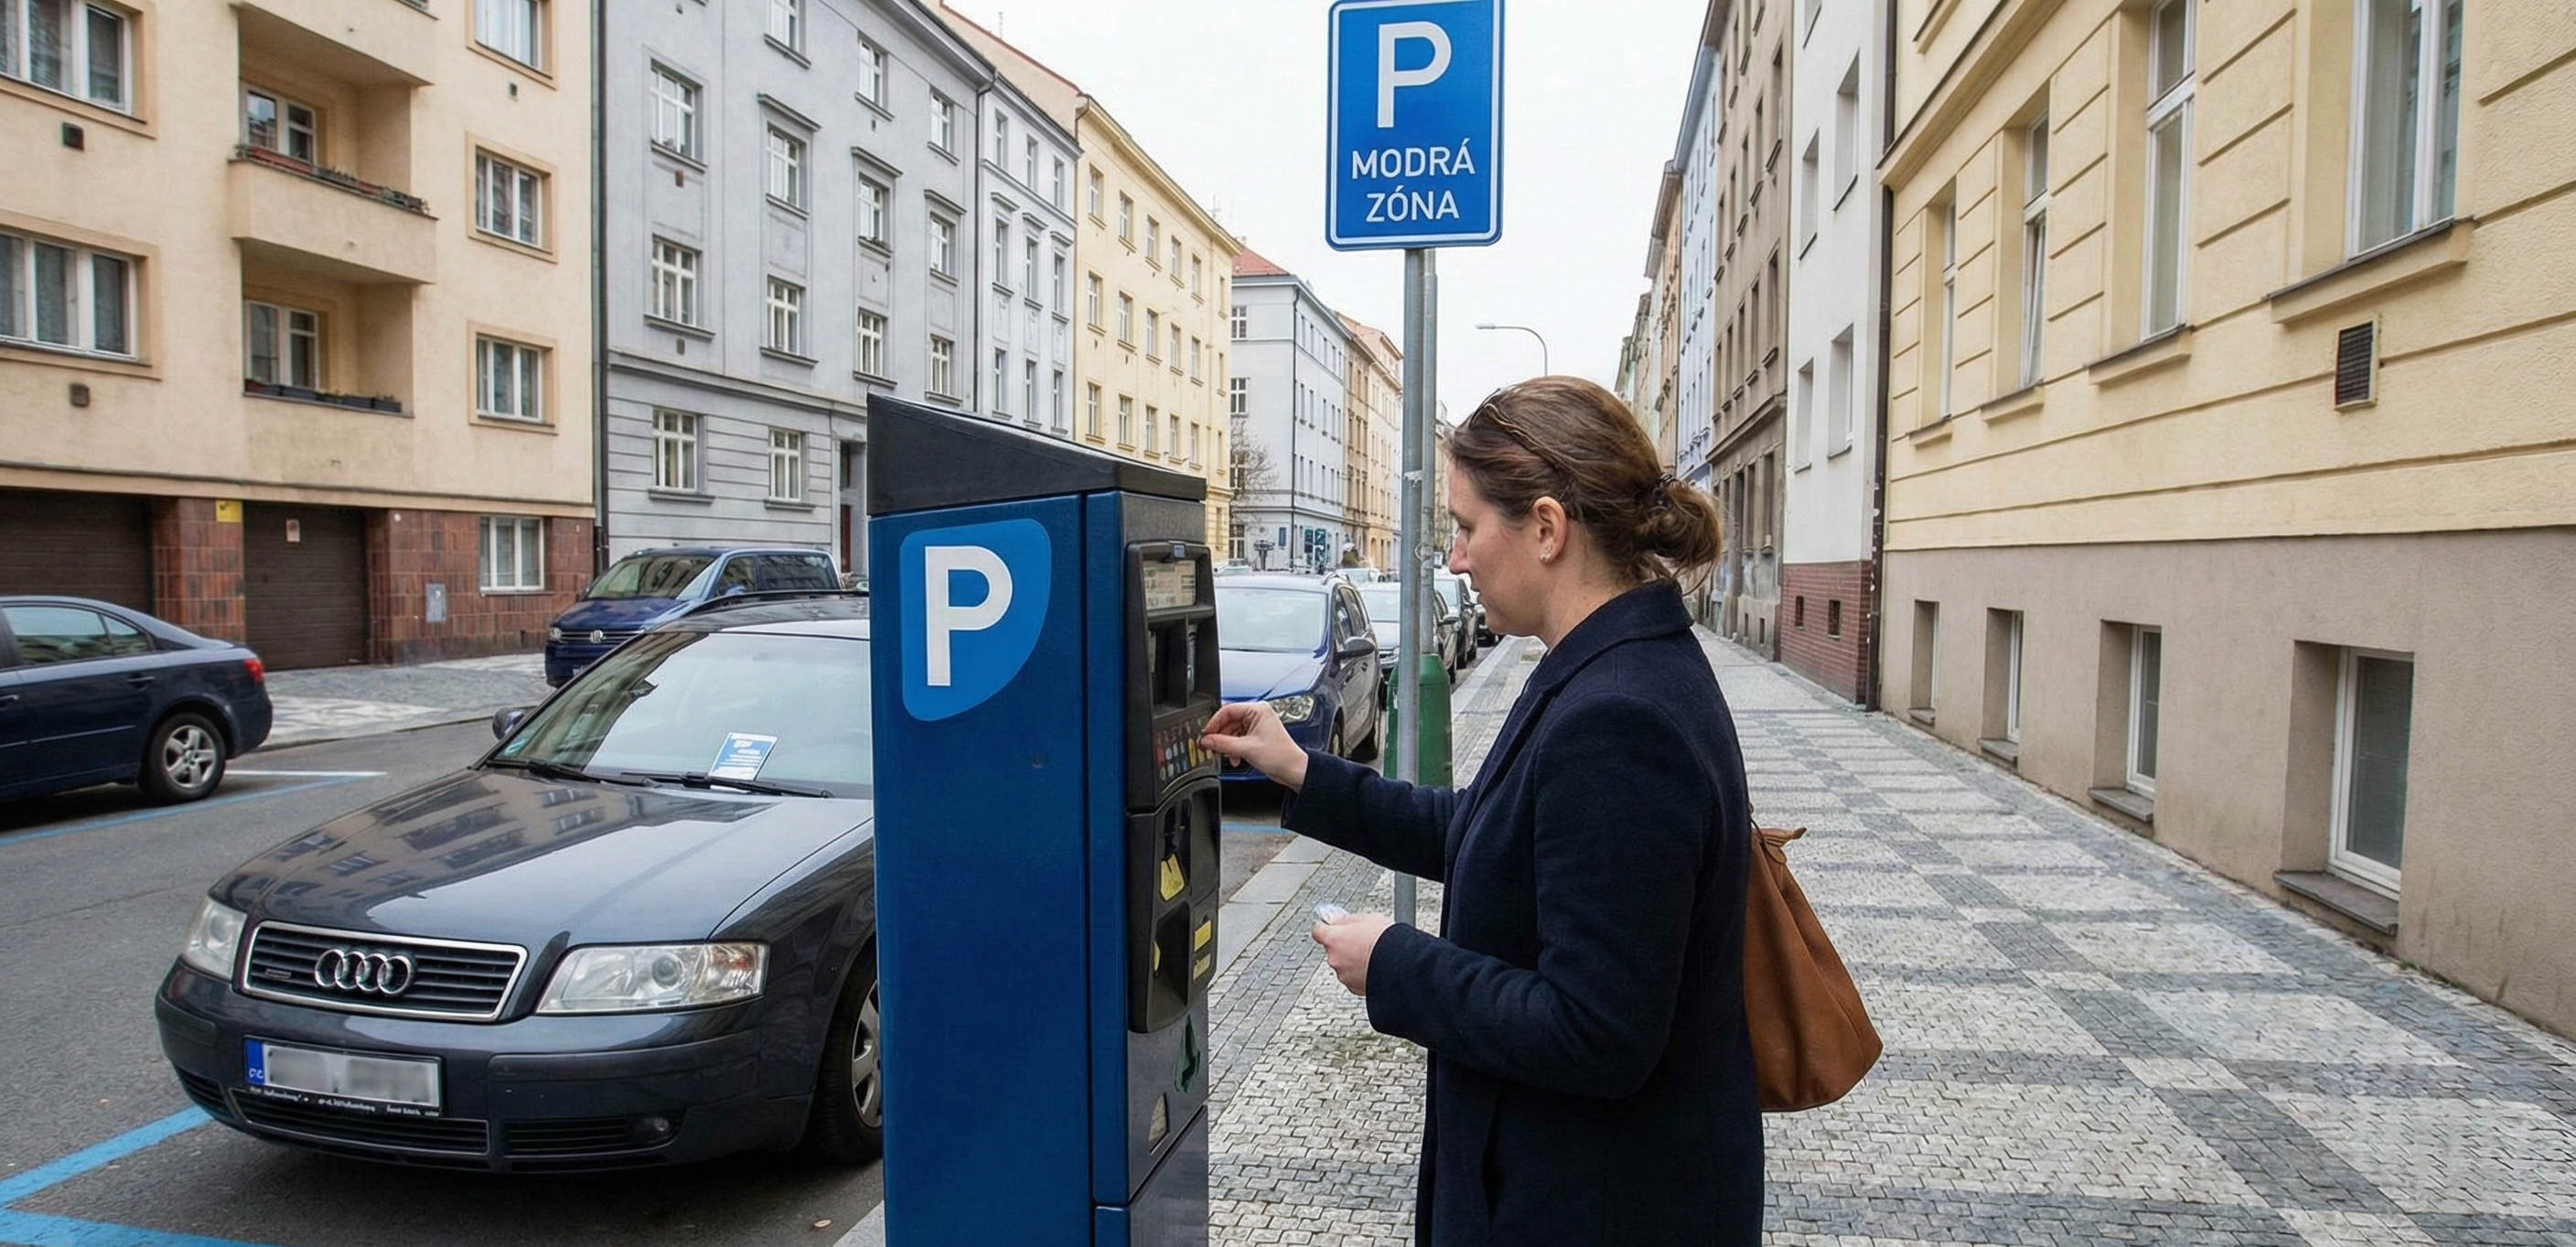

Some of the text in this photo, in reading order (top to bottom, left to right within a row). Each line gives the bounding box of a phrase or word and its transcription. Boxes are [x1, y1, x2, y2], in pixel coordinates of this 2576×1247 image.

[1378, 21, 1452, 128] P
[1352, 138, 1476, 179] MODRÁ
[1366, 185, 1460, 222] ZÓNA
[925, 545, 1013, 686] P
